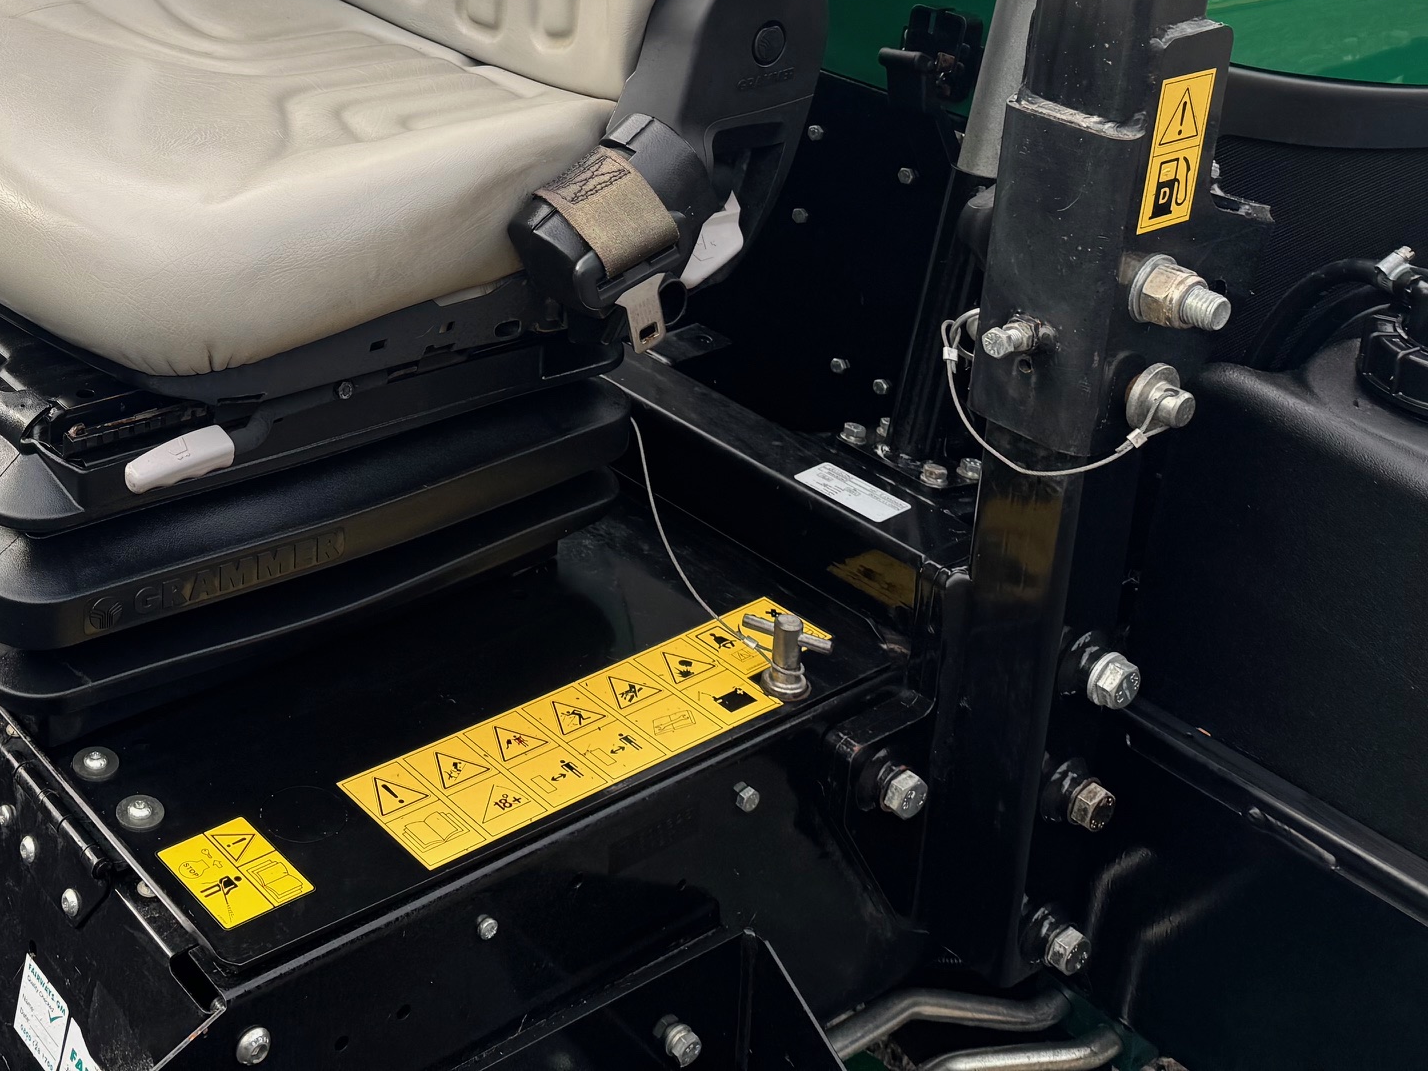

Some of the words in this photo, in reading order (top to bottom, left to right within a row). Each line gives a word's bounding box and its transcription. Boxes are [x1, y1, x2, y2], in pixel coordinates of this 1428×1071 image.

[1158, 187, 1170, 204] D
[134, 530, 341, 615] GRAMMER
[183, 862, 200, 877] STOP
